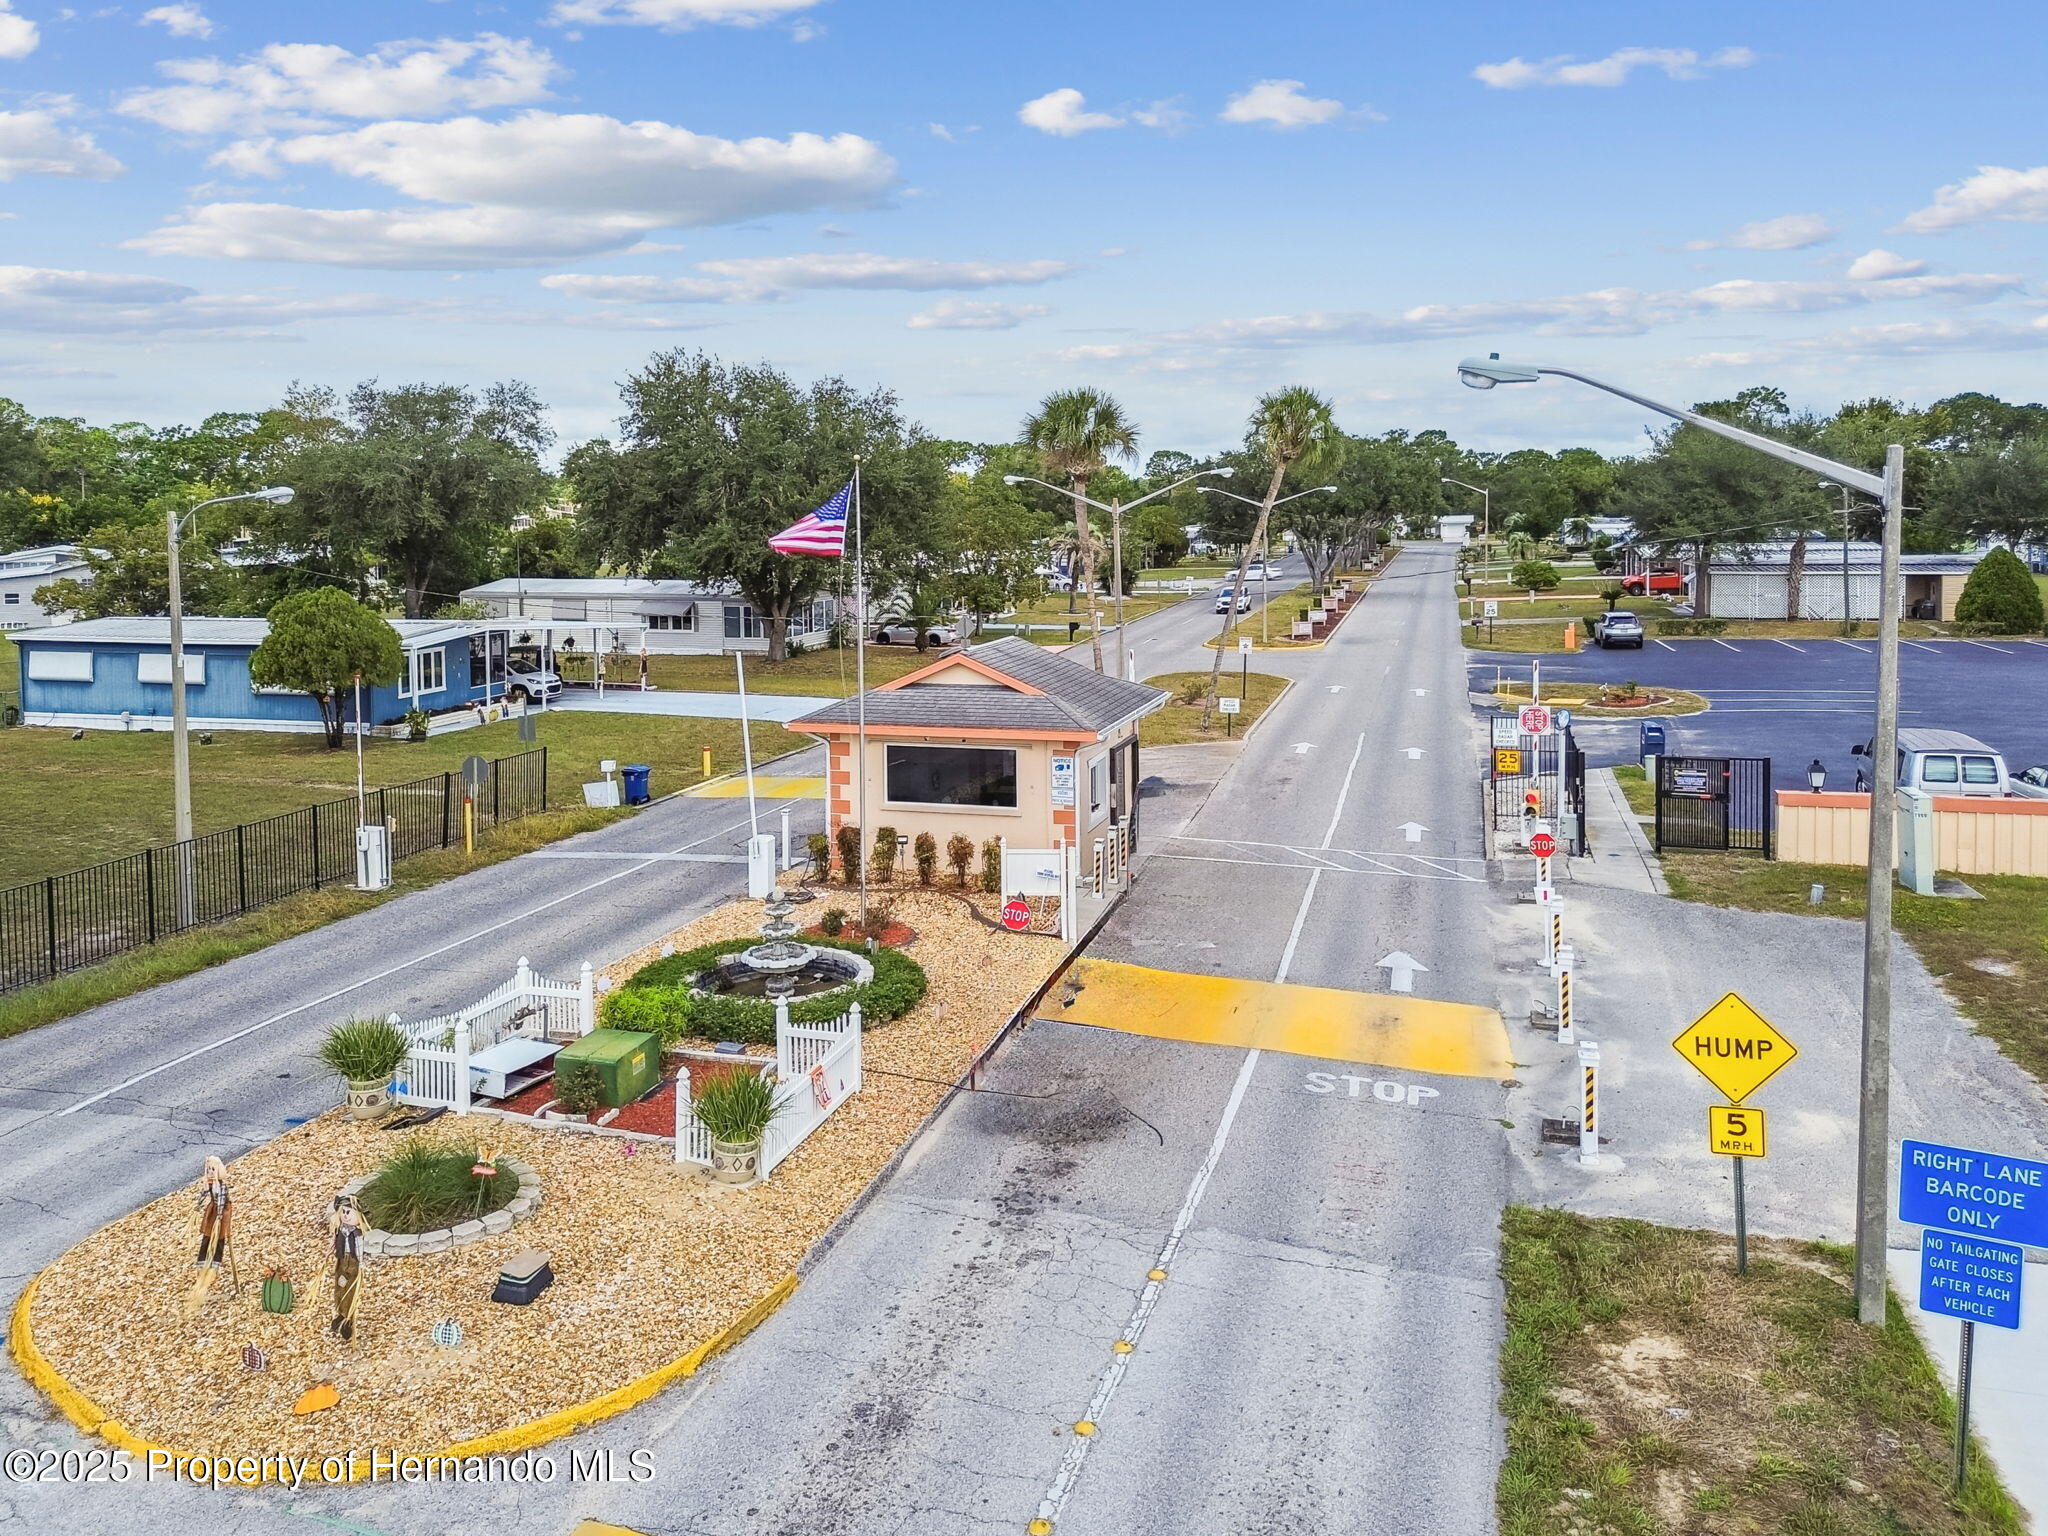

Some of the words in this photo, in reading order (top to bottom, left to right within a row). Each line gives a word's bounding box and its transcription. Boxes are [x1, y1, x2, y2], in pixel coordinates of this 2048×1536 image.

[1535, 710, 1544, 730] STOP
[1499, 753, 1518, 764] 25
[1530, 840, 1555, 851] STOP
[1003, 908, 1030, 923] STOP
[1695, 1035, 1773, 1061] HUMP
[1304, 1071, 1441, 1106] STOP
[1727, 1113, 1748, 1137] 5
[1913, 1149, 1974, 1174] RIGHT
[1983, 1162, 2042, 1188] LANE
[1926, 1177, 2026, 1210] BARCODE
[1947, 1206, 2001, 1230] ONLY
[1926, 1237, 1943, 1250] NO
[1950, 1241, 2019, 1265] TAILGATING
[1929, 1256, 1959, 1272] GATE
[1965, 1263, 2014, 1283] CLOSES
[1931, 1275, 1971, 1293] AFTER
[1977, 1284, 2010, 1301] EACH
[1944, 1296, 1995, 1317] VEHICLE
